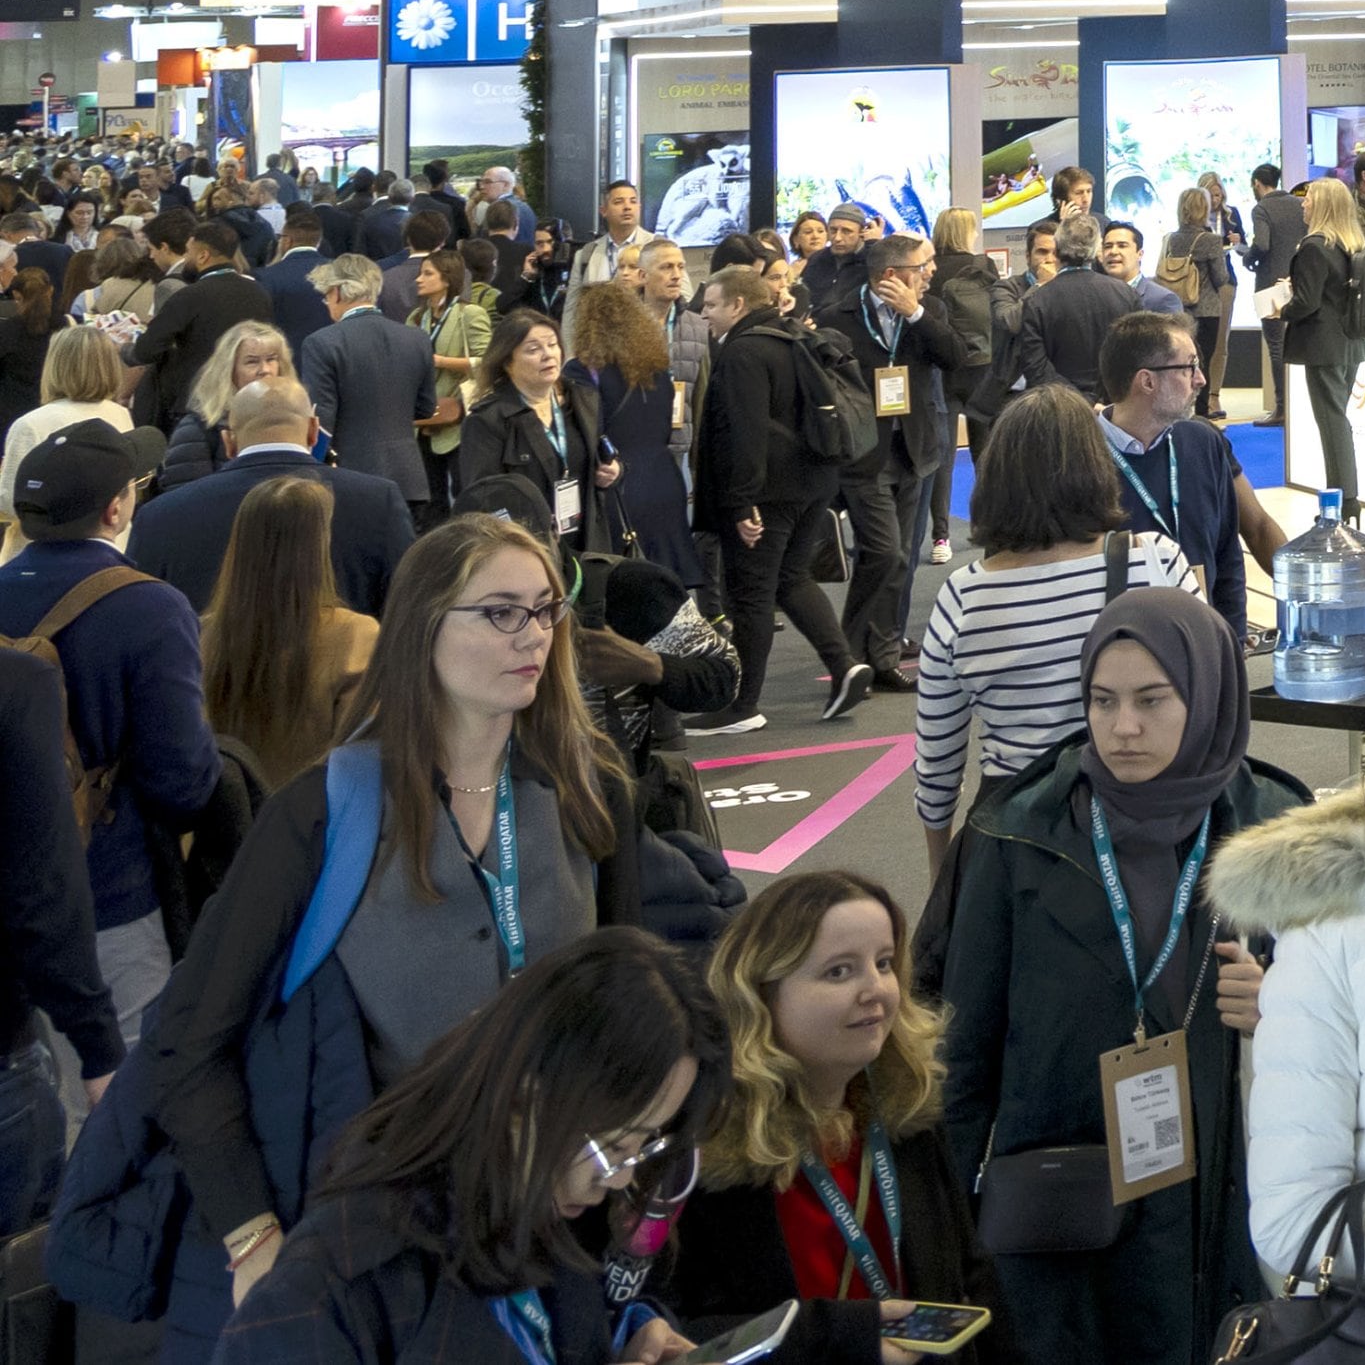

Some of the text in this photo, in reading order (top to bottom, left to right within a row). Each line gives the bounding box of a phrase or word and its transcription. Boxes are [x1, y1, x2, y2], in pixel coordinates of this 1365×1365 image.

[658, 85, 705, 99] LORO
[499, 810, 513, 870] visitQATAR
[1100, 853, 1124, 911] visitQATAR
[1177, 859, 1197, 916] visitQATAR
[506, 884, 520, 946] visitQATAR
[820, 1179, 862, 1241] visitQATAR
[875, 1150, 898, 1218] visitQATAR
